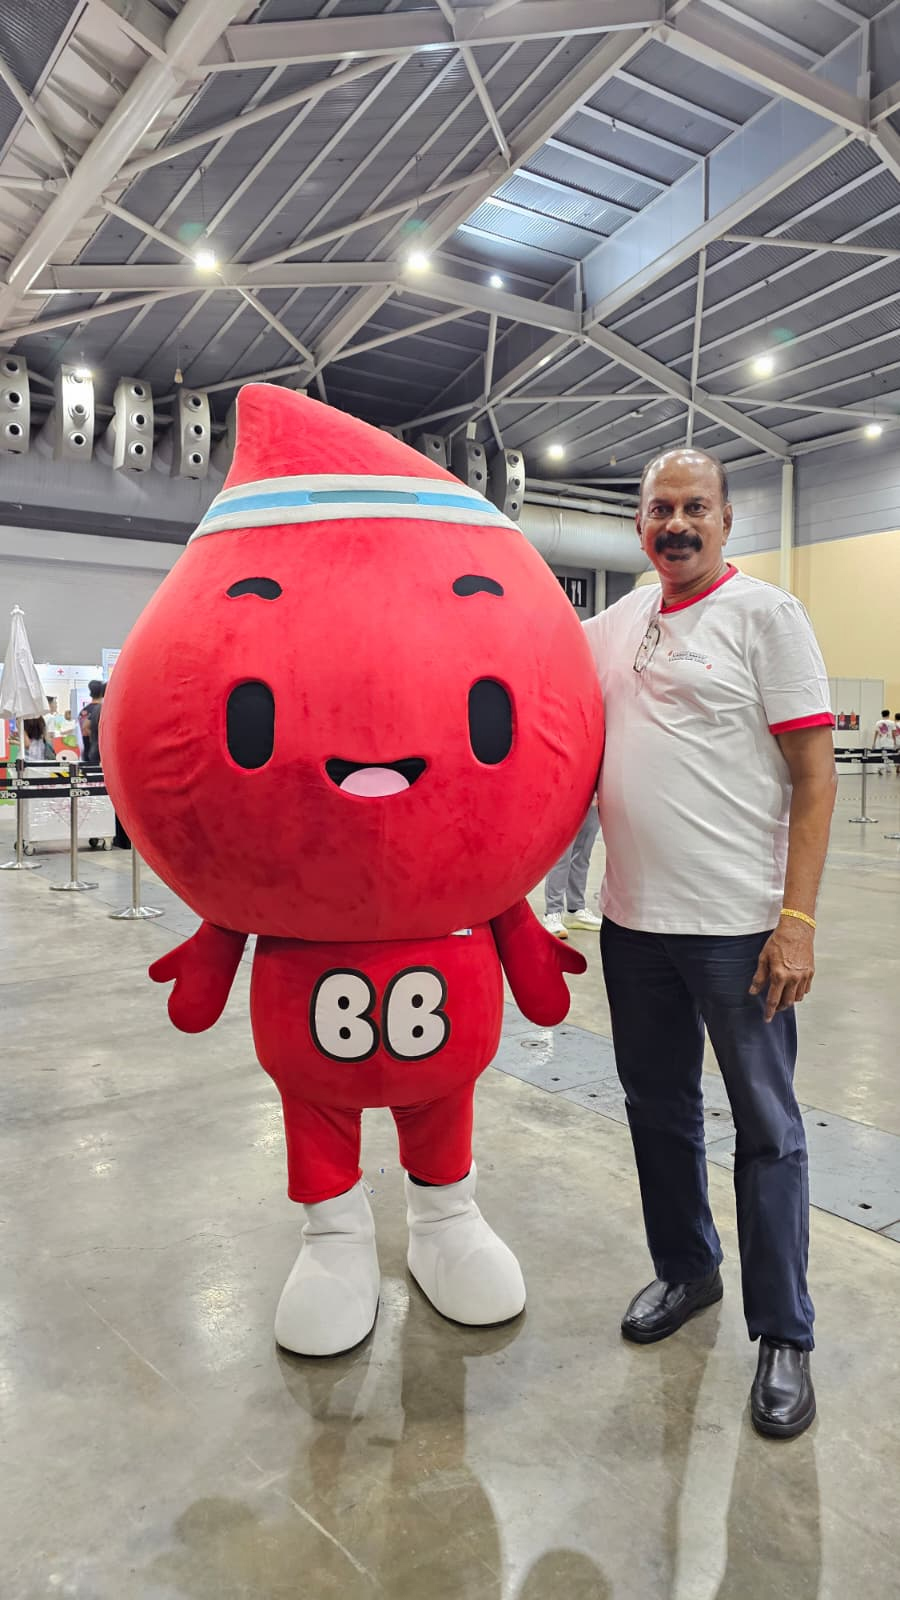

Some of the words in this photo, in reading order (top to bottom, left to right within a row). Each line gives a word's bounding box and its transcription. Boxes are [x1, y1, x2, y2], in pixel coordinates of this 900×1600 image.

[0, 790, 17, 799] XPO
[70, 788, 90, 797] EXPO
[308, 965, 452, 1063] BB
